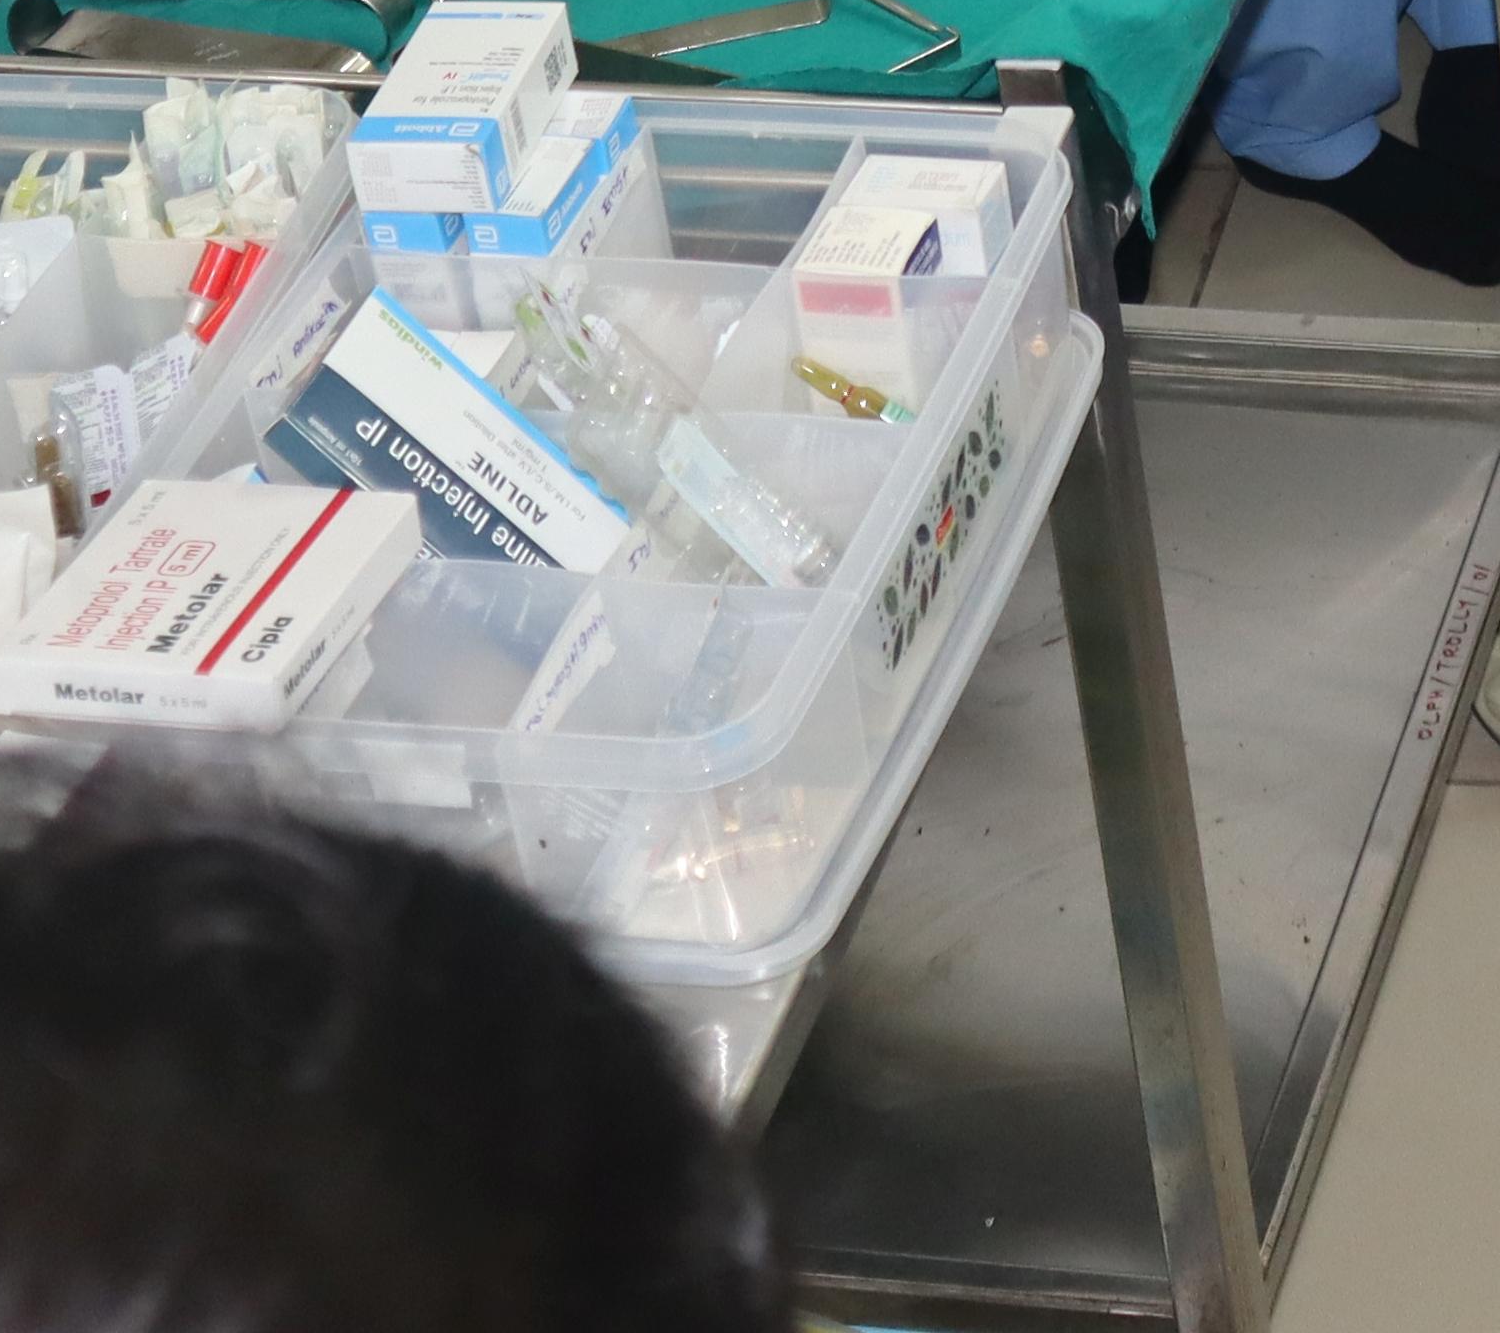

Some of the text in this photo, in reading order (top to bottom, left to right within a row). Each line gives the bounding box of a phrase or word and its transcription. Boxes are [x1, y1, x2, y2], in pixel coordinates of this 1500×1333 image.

[394, 123, 448, 133] Abbott
[356, 418, 388, 447] IP
[389, 436, 491, 536] Injection
[467, 451, 549, 525] ADLINE
[47, 581, 133, 648] Metoprolol
[109, 527, 178, 574] Tartrate
[95, 544, 206, 651] Injection IP 5 ml
[145, 572, 229, 653] Metolar
[241, 615, 294, 663] Cipla
[283, 638, 326, 699] Metolar
[54, 683, 145, 705] Metolar
